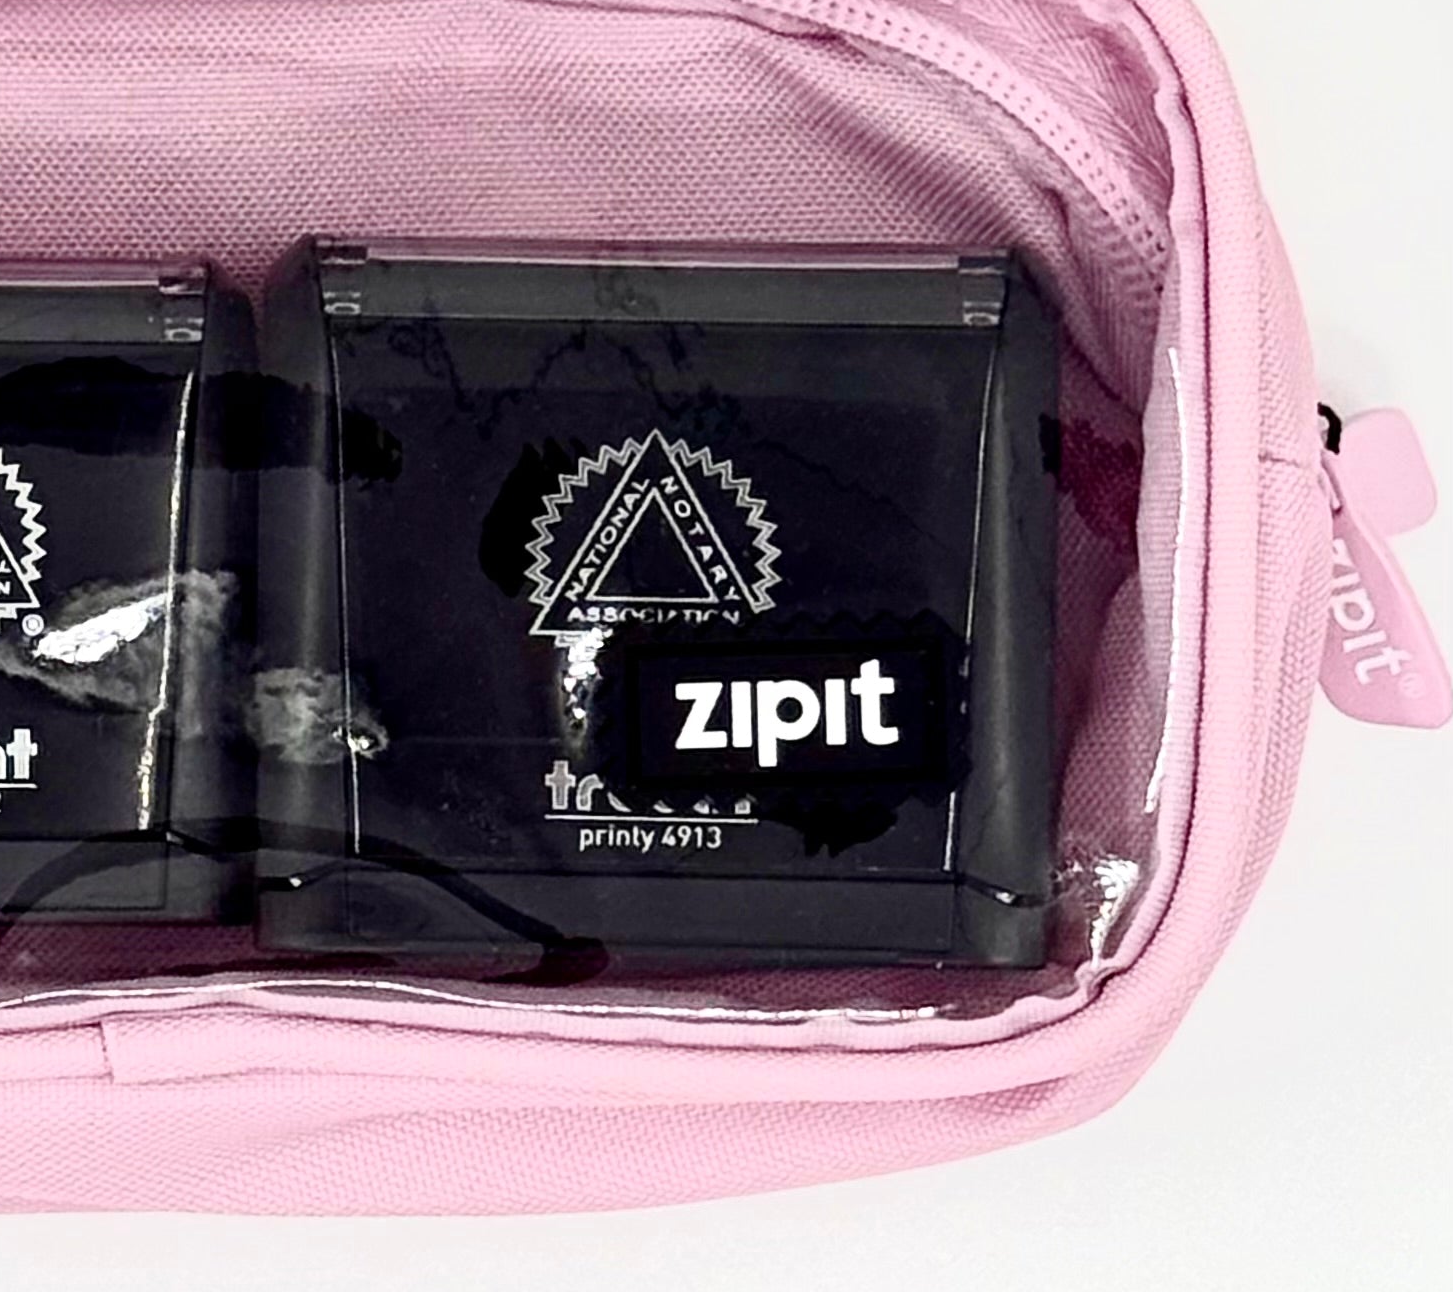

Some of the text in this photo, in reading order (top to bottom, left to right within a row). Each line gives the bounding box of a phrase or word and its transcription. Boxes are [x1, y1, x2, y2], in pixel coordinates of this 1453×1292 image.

[564, 479, 650, 602] NATIONAL
[659, 476, 742, 602] NOTARY
[579, 824, 722, 853] printy 4913
